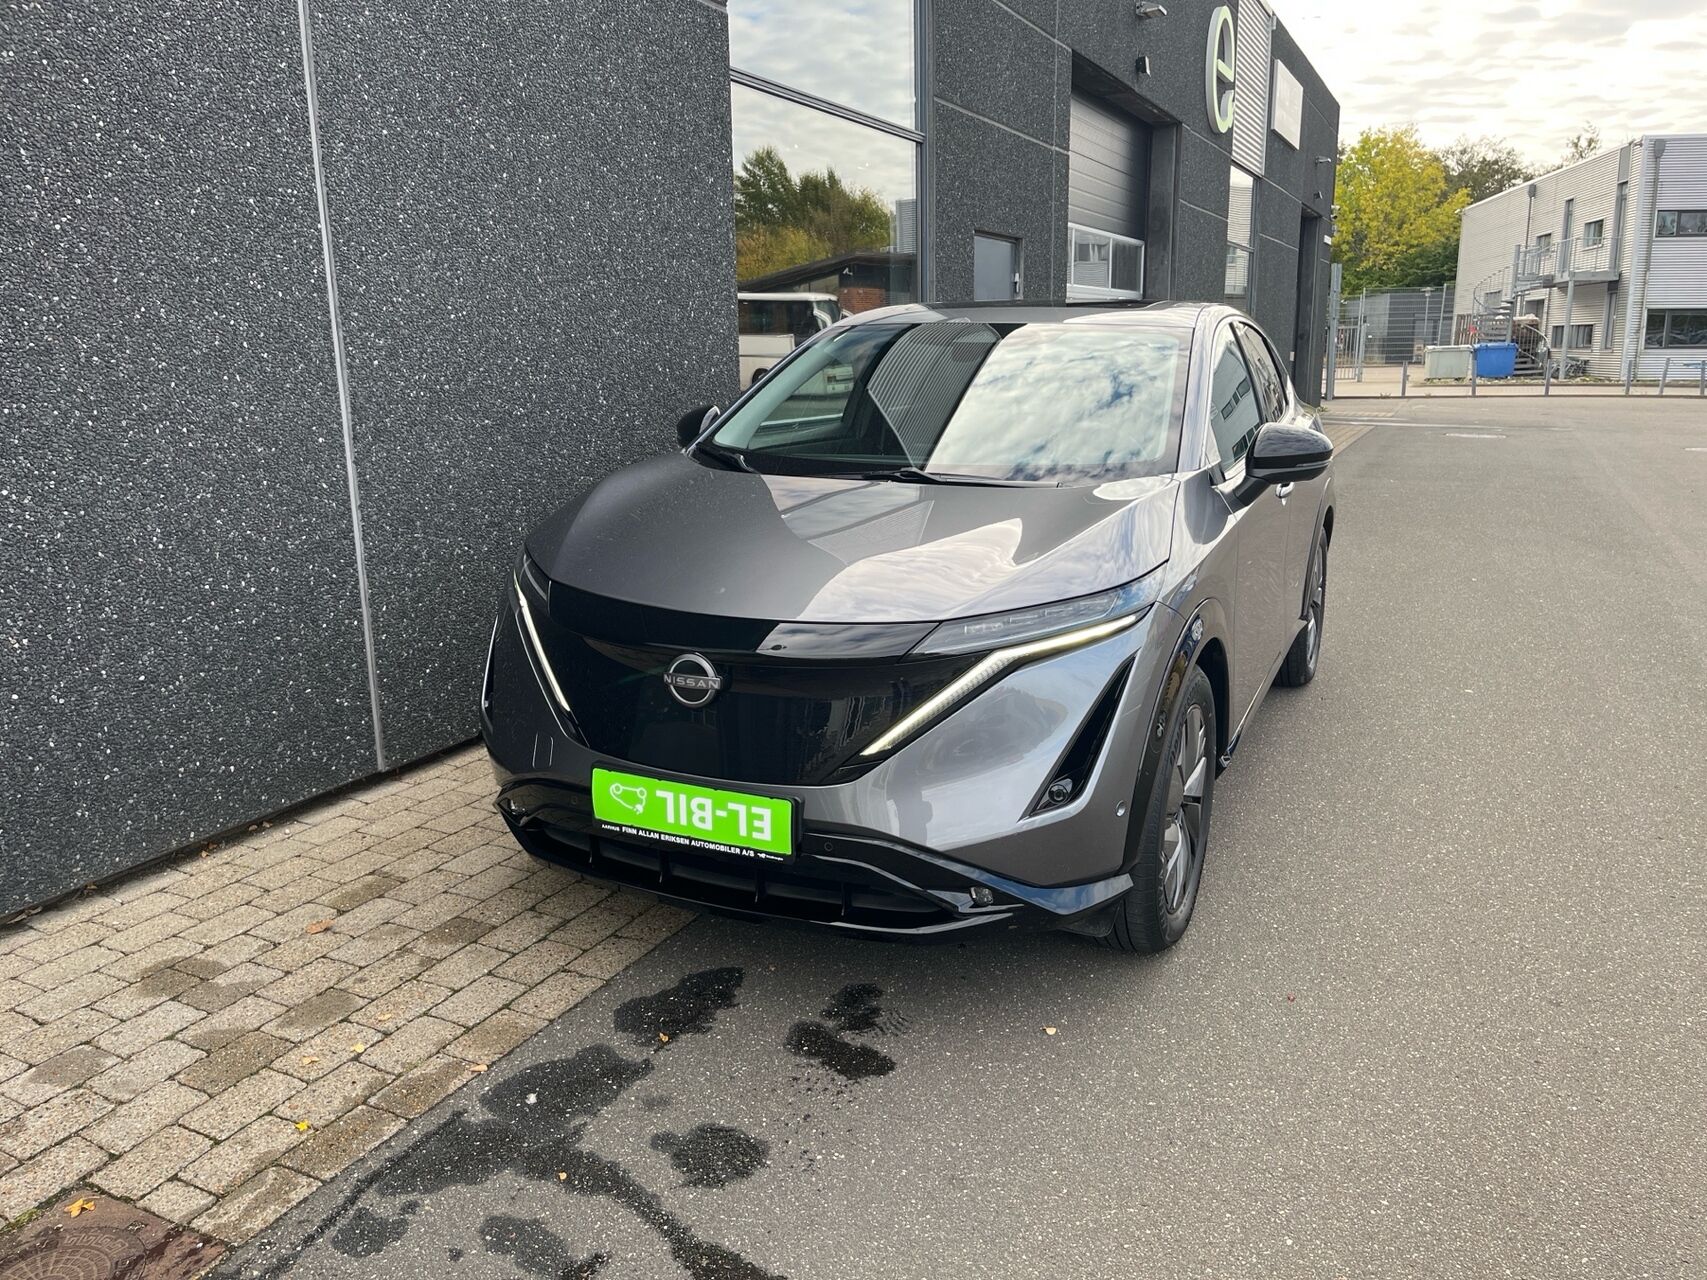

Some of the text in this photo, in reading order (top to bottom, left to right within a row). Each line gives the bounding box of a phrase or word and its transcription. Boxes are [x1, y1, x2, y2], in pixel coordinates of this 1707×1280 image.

[1205, 5, 1235, 134] e
[663, 673, 719, 689] NISSAN
[655, 789, 772, 842] EL-BIL
[621, 826, 638, 835] FINN
[638, 829, 660, 840] ALLAN
[660, 833, 690, 845] ERIKSEN
[690, 839, 741, 855] AUTOMOBILER
[742, 849, 755, 857] A/S
